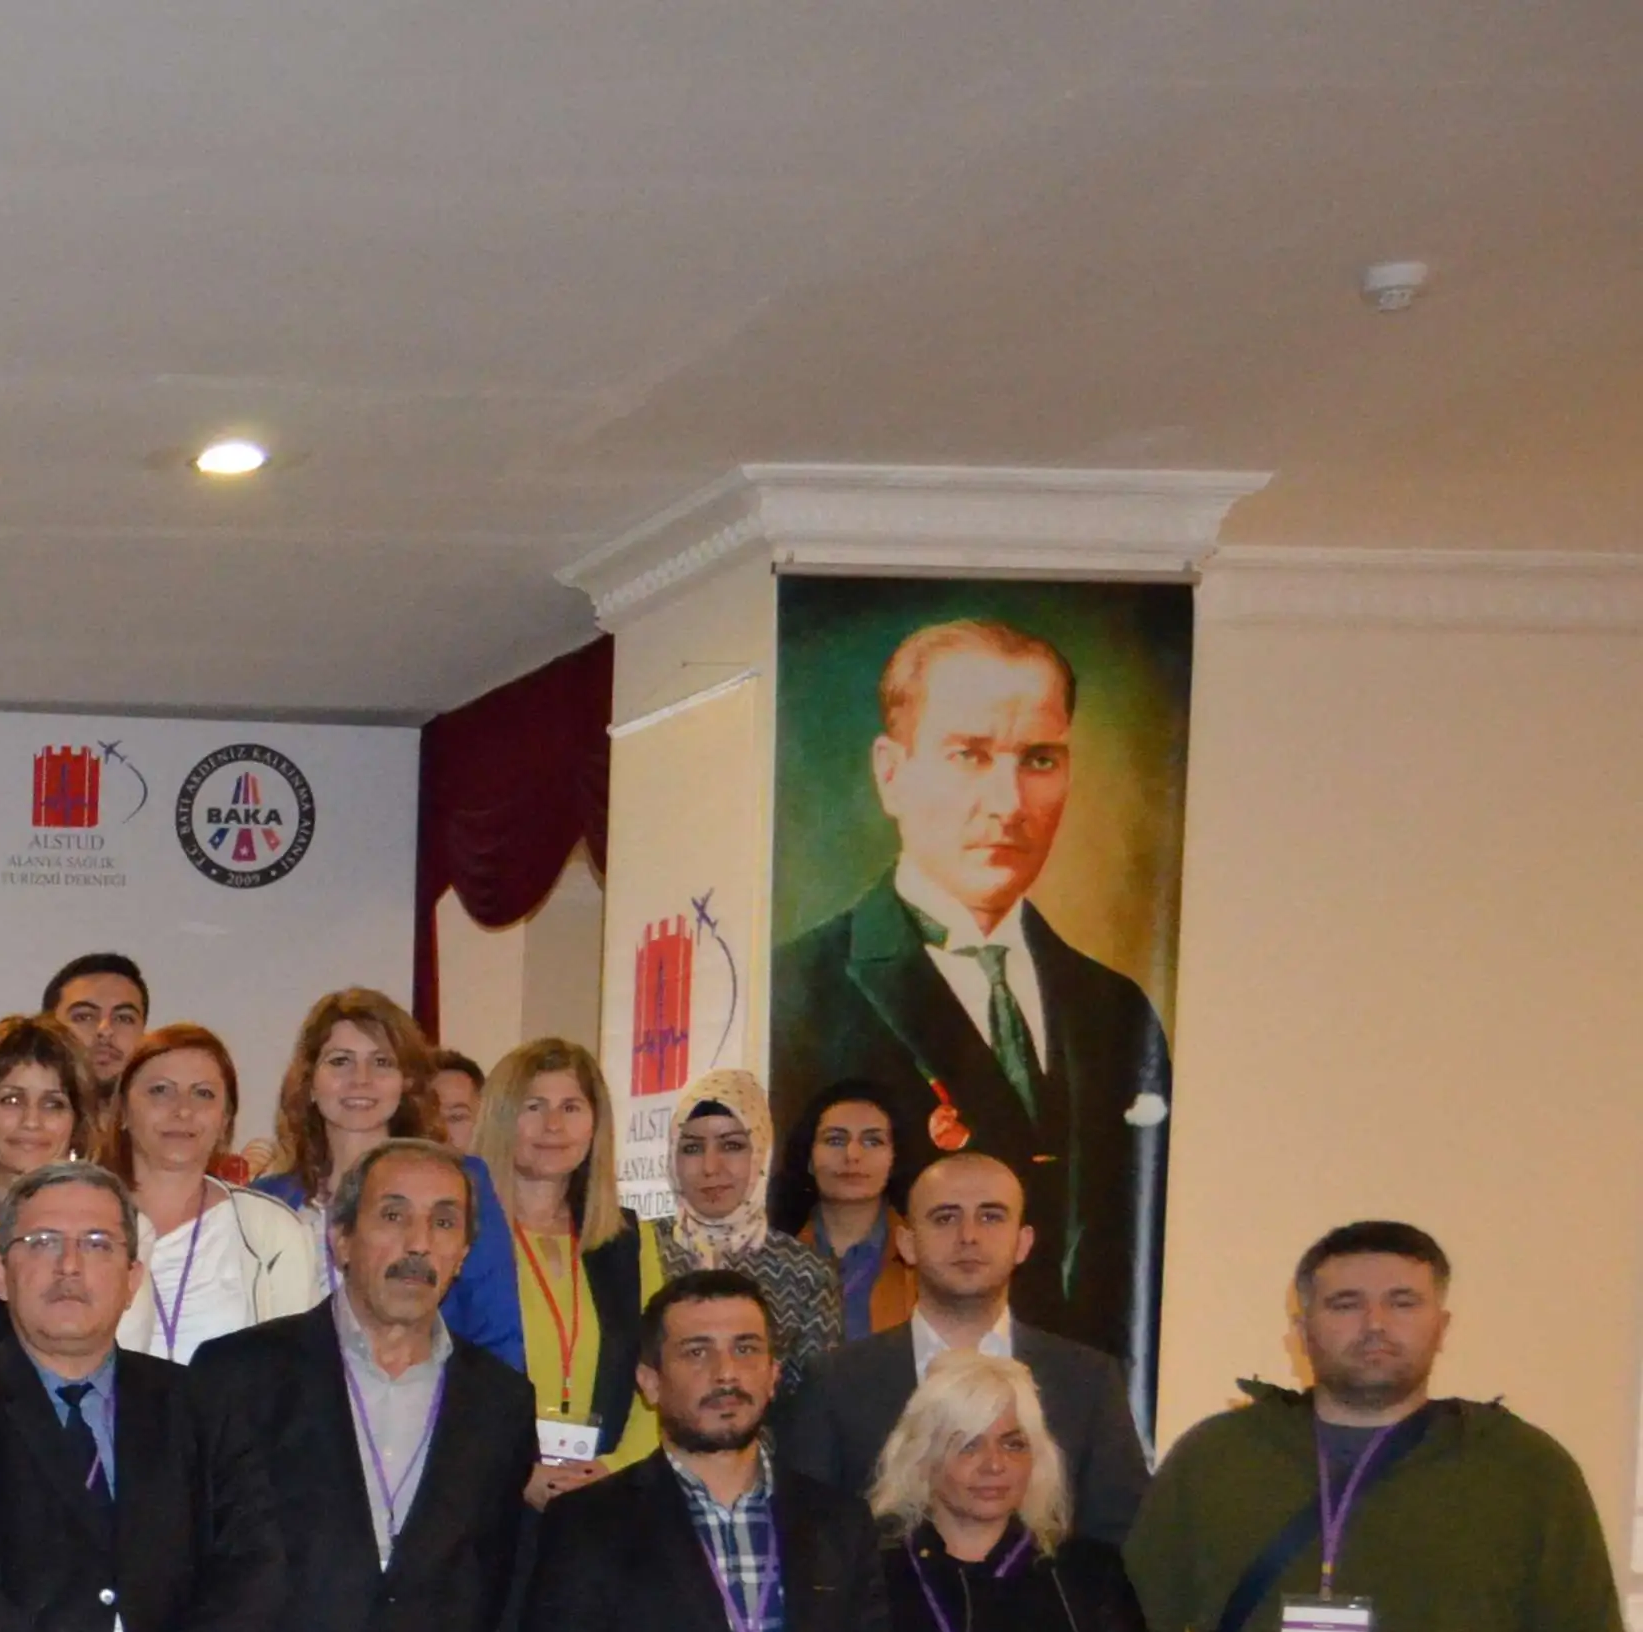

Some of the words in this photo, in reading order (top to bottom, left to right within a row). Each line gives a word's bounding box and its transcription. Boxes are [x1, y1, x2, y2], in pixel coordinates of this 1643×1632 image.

[206, 808, 284, 826] BAKA
[28, 833, 106, 851] ALSTUD
[226, 871, 261, 887] 2009
[615, 1155, 656, 1182] LANYA
